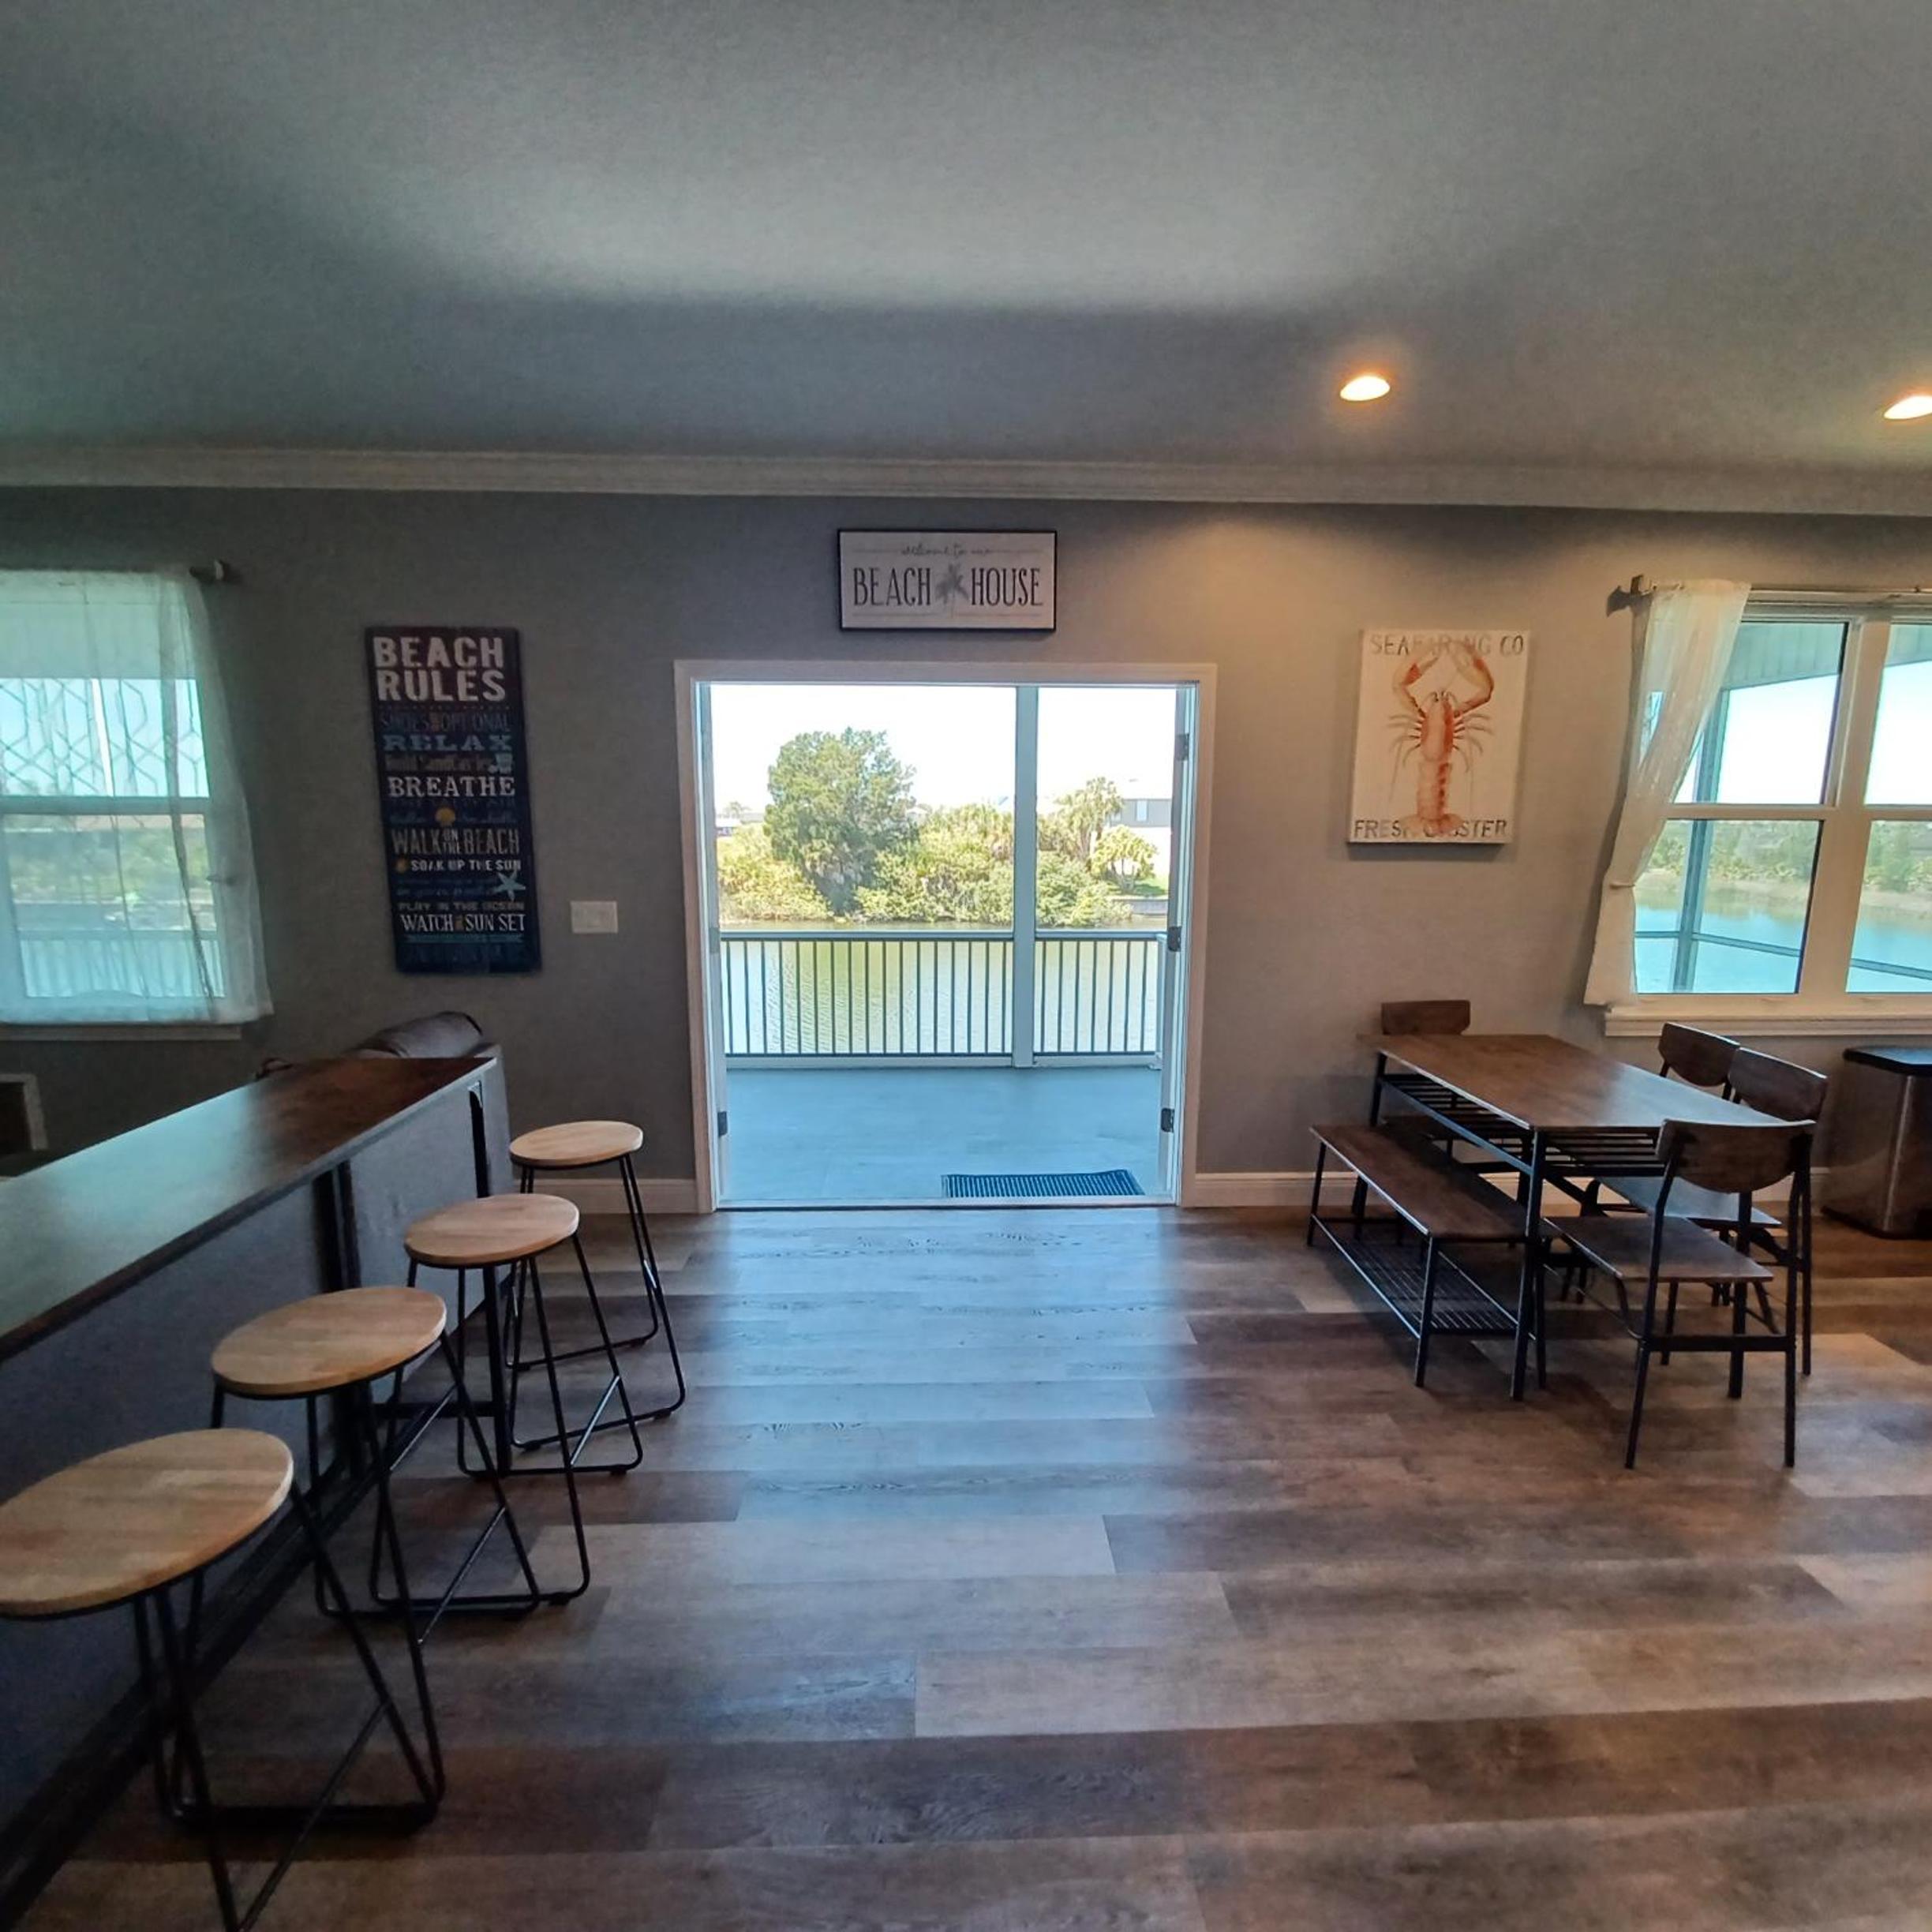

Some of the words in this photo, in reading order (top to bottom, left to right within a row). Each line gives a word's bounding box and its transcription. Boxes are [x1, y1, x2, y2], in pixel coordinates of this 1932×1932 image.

[854, 567, 930, 606] BEACH
[971, 567, 1043, 606] HOUSE
[373, 636, 504, 668] BEACH
[376, 669, 506, 702] RULES
[383, 735, 513, 751] RELAX
[388, 776, 516, 797] BREATHE
[391, 829, 441, 855] WALK
[463, 829, 520, 855] BEACH
[496, 859, 522, 871] SUN
[400, 914, 454, 932] WATCH
[465, 914, 494, 932] SUN
[498, 914, 526, 932] SET
